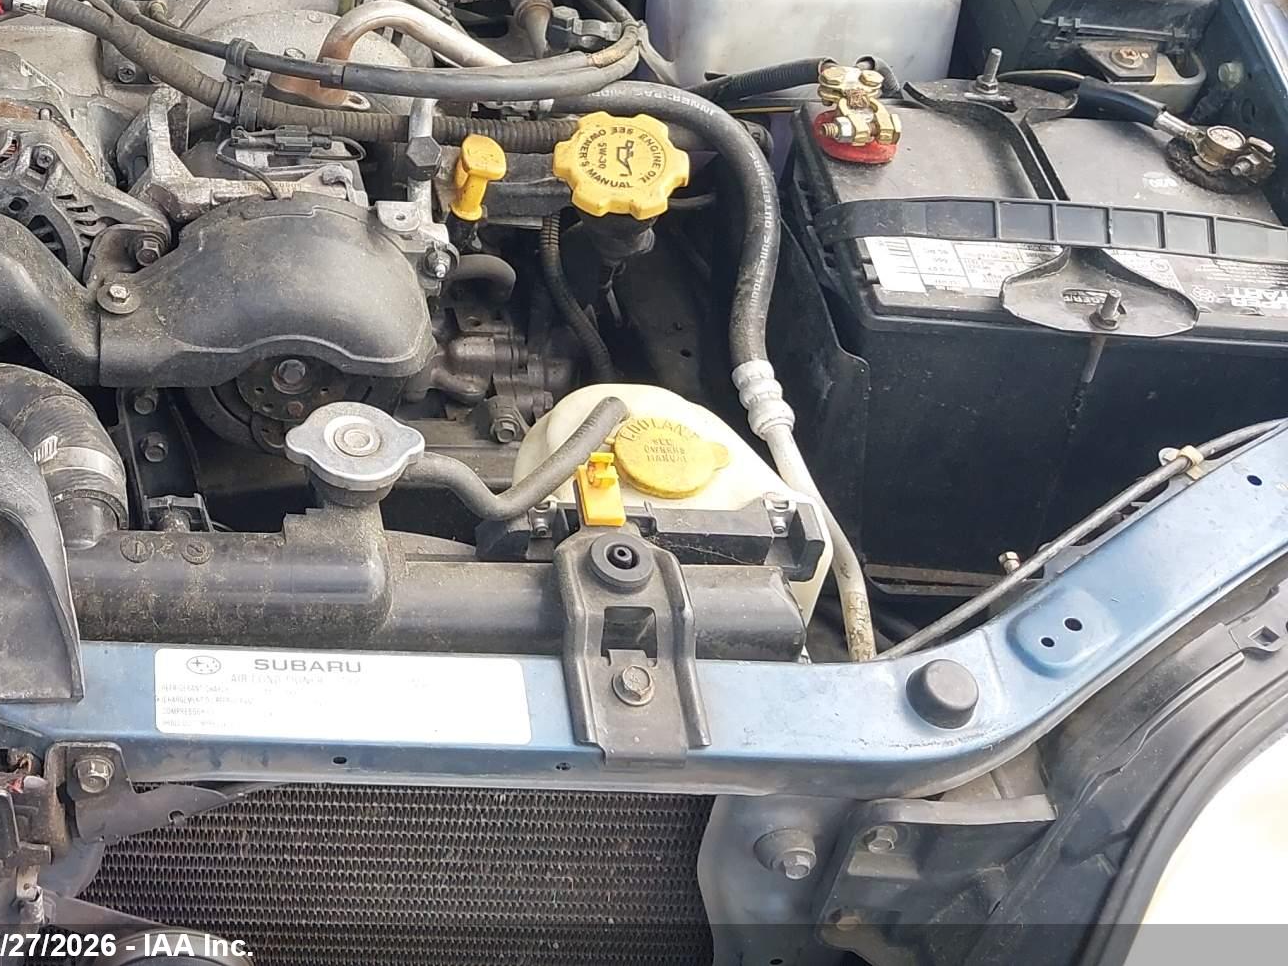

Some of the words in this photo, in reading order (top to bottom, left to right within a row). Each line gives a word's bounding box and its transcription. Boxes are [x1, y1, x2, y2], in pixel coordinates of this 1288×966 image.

[611, 126, 634, 136] SEE
[597, 142, 608, 169] 5W-30
[638, 134, 662, 170] ENGINE
[587, 169, 633, 189] MANUAL
[639, 170, 658, 185] OIL
[254, 658, 362, 674] SUBARU
